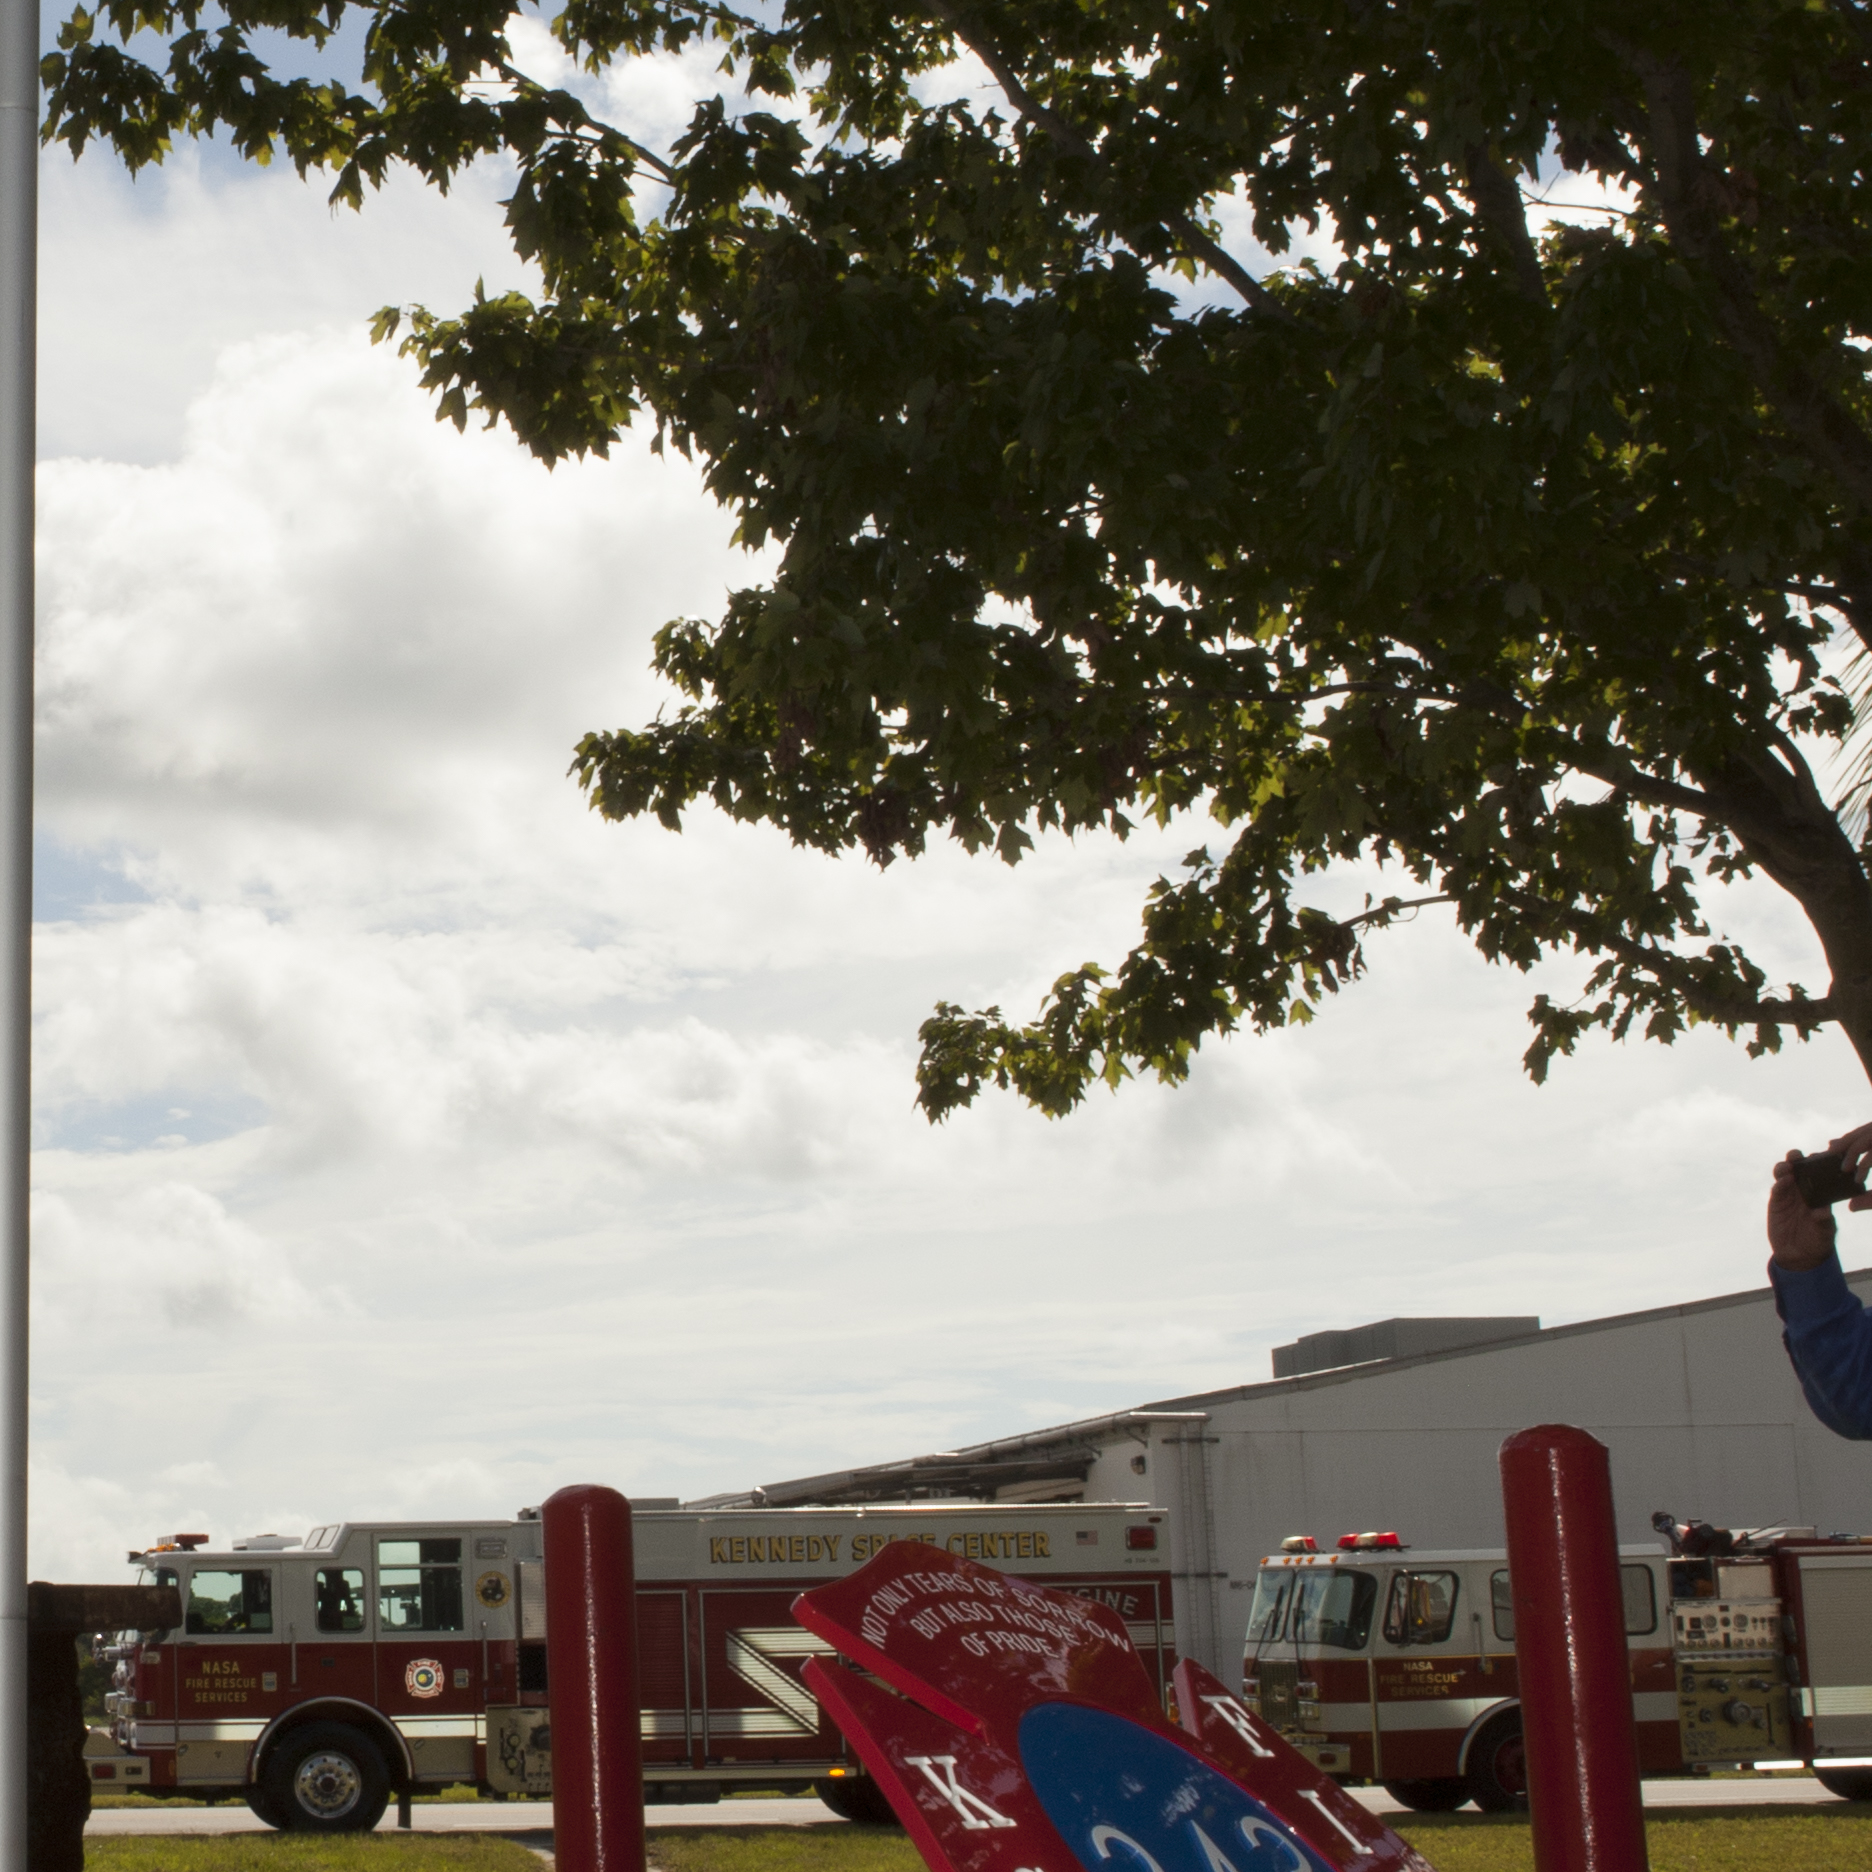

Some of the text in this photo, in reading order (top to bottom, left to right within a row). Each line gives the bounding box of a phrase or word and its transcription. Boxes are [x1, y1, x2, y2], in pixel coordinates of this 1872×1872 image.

[710, 1535, 842, 1563] KENNEDY
[946, 1532, 1051, 1559] CENTER
[861, 1572, 1129, 1652] NOT ONLY TEARS OF SORROW
[910, 1601, 1081, 1645] BUT ALSO THOSE
[960, 1631, 1059, 1658] OF PRIDE
[202, 1661, 240, 1674] NASA
[1403, 1661, 1434, 1671] NASA
[185, 1677, 257, 1689] FIRE RESCUE
[1411, 1673, 1459, 1684] RESCUE
[1391, 1685, 1449, 1696] SERVICES
[194, 1692, 248, 1703] SERVICES
